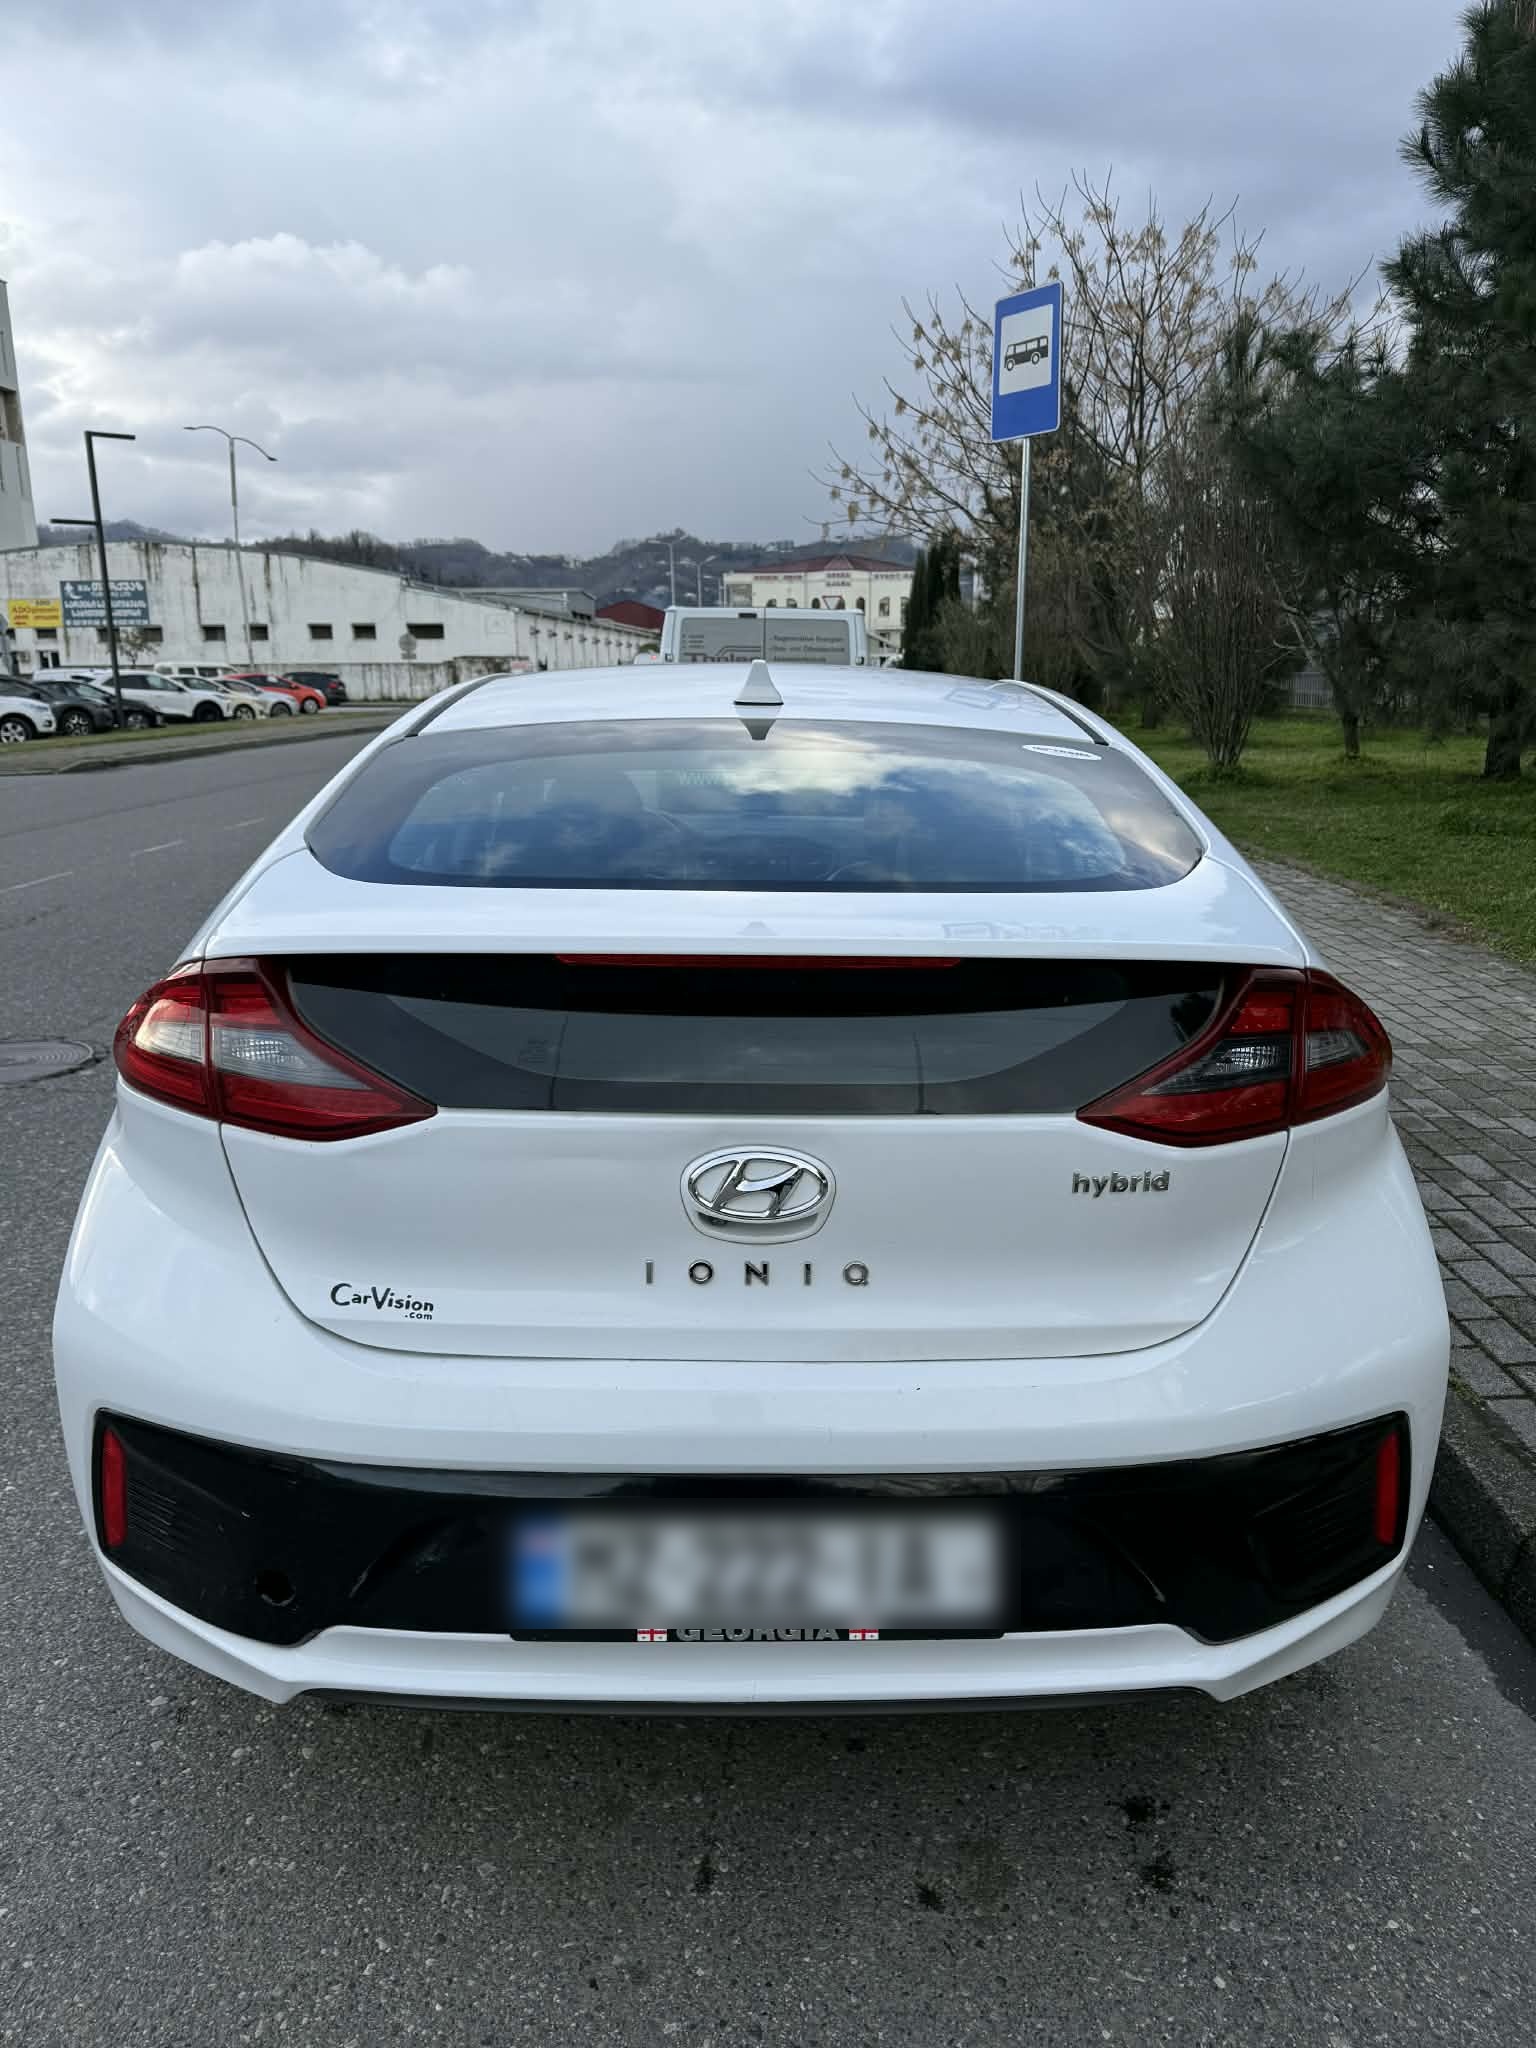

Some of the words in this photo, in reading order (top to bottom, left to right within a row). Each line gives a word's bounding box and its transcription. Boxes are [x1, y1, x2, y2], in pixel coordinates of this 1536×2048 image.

[1072, 1169, 1170, 1198] hybrid
[645, 1259, 869, 1286] IONIQ
[330, 1282, 434, 1312] CarVision
[404, 1311, 433, 1321] .com
[676, 1628, 841, 1641] GEORGIA
